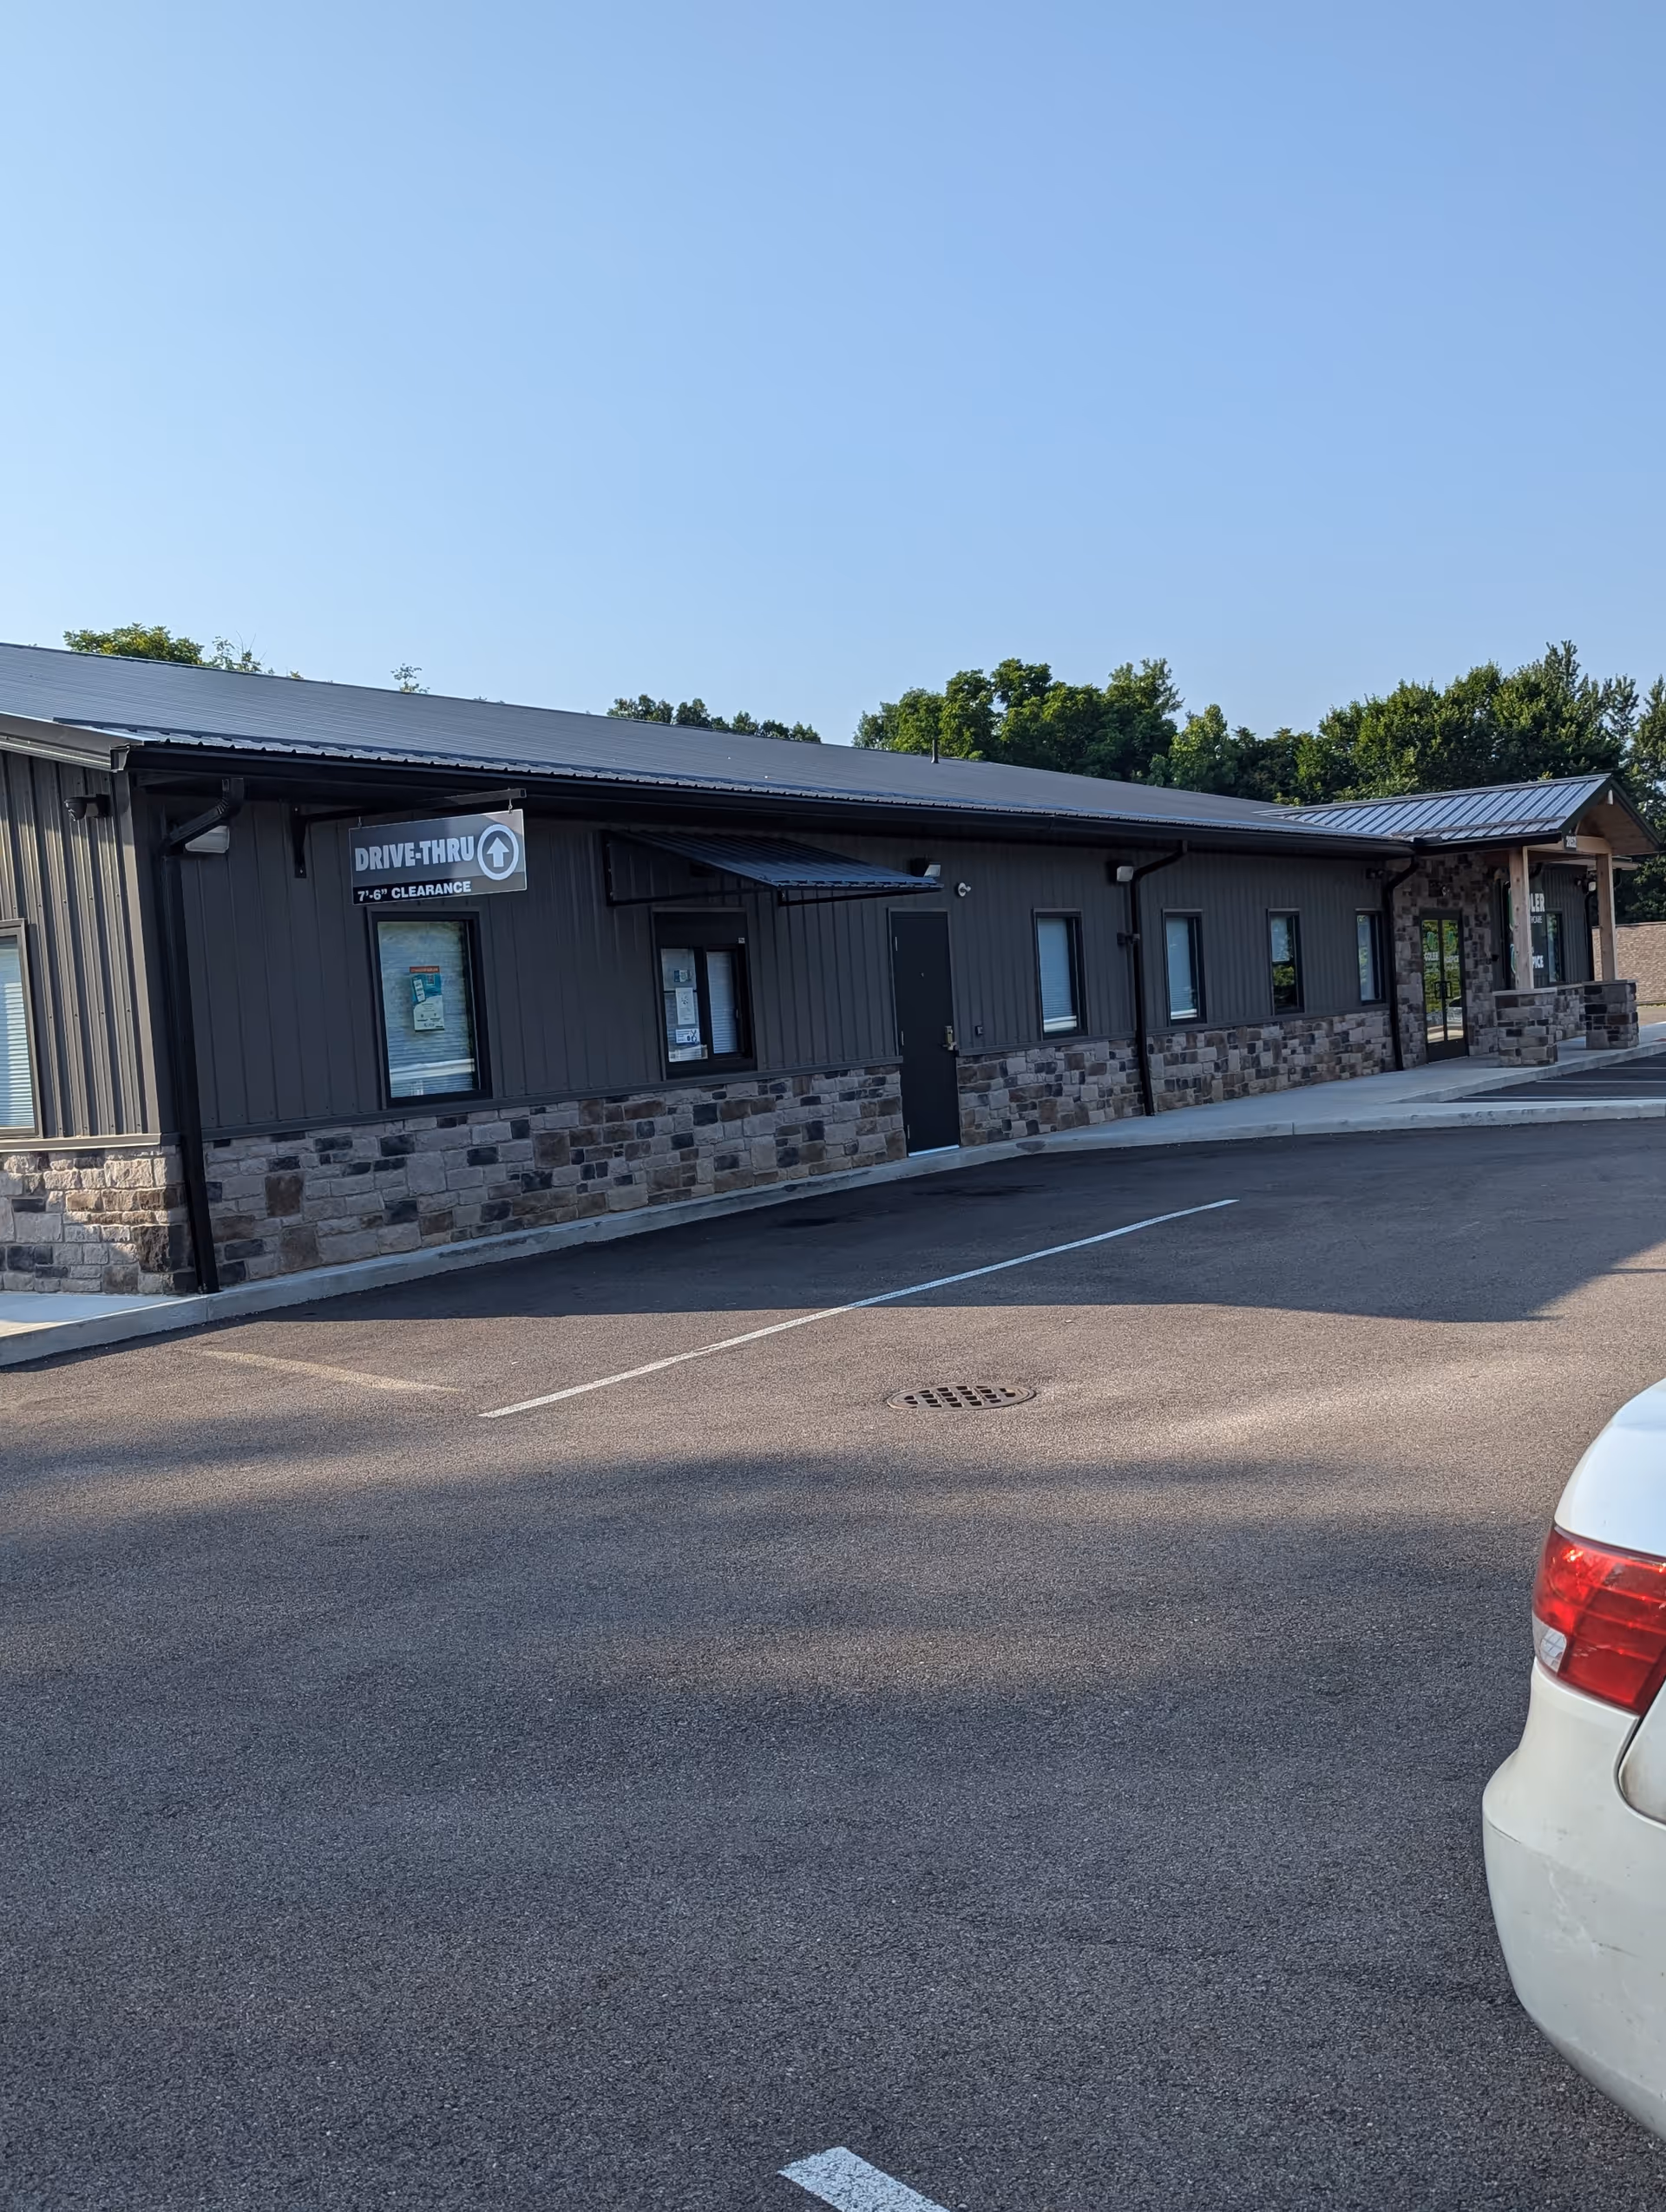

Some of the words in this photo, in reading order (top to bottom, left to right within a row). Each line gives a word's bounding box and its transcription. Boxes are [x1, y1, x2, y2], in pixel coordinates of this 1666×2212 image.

[355, 835, 475, 872] DRIVE-THRU
[391, 880, 472, 899] CLEARANCE
[1530, 893, 1545, 912] LER
